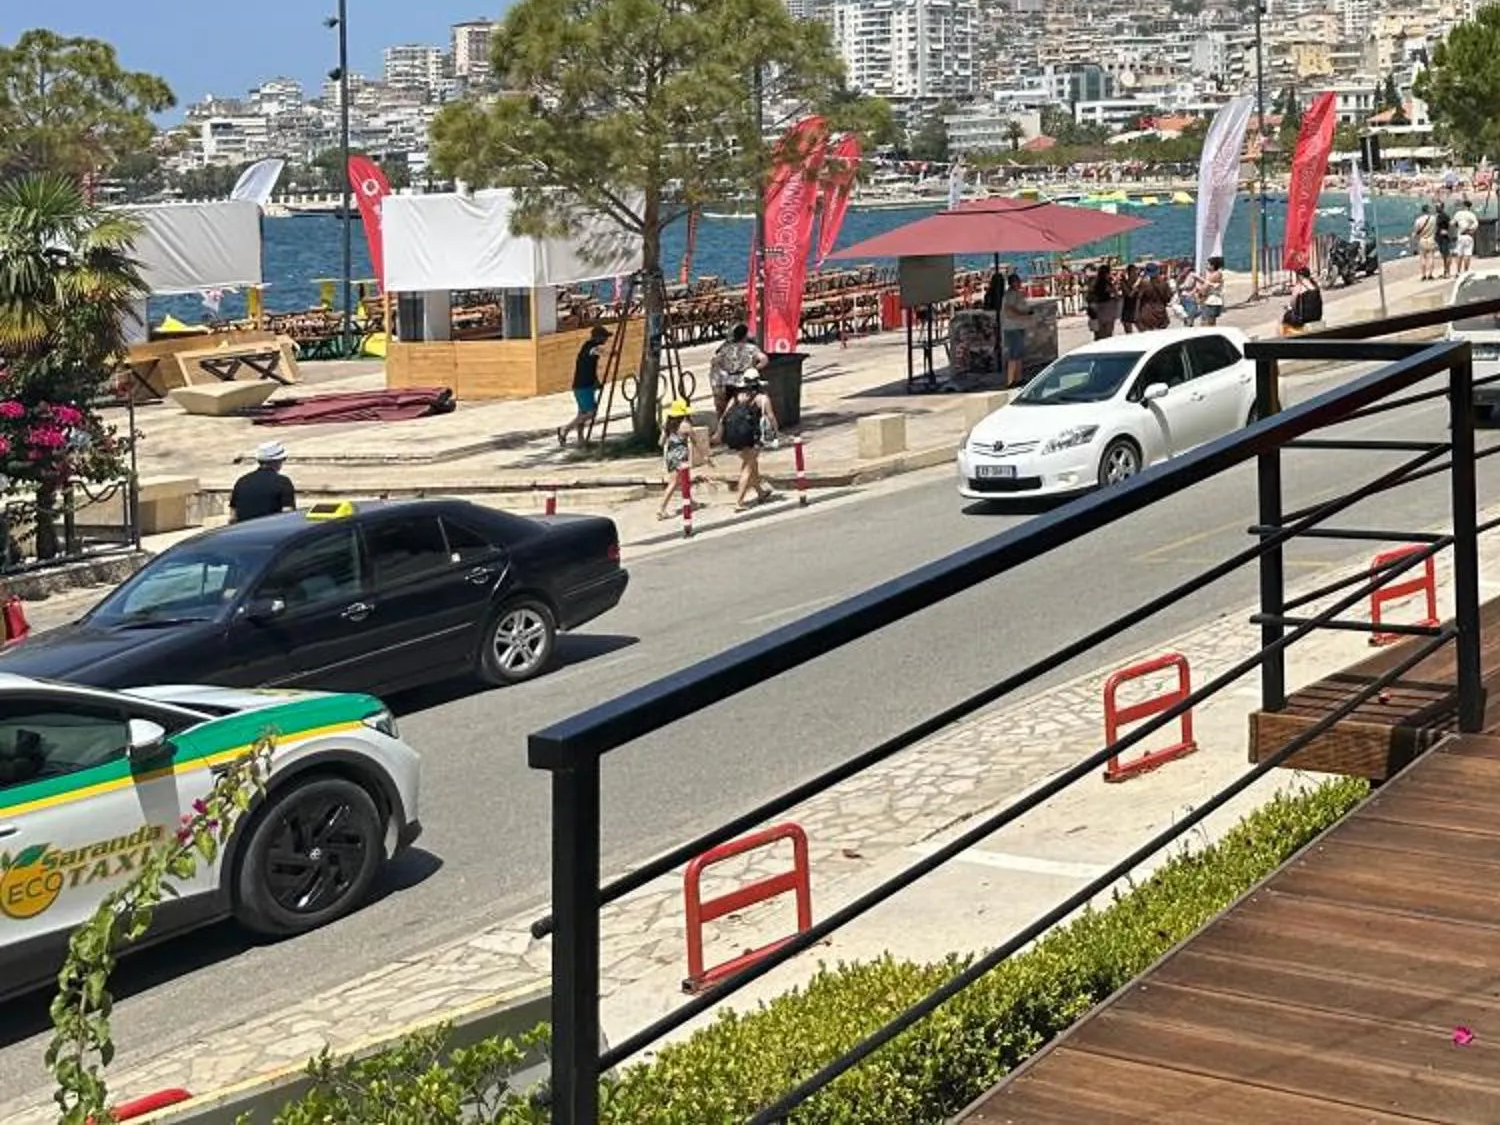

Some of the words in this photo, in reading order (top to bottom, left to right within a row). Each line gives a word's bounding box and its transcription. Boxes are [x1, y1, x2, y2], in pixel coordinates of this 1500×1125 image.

[43, 825, 163, 870] Saranda
[69, 846, 151, 889] TAXI
[8, 871, 63, 905] ECO
